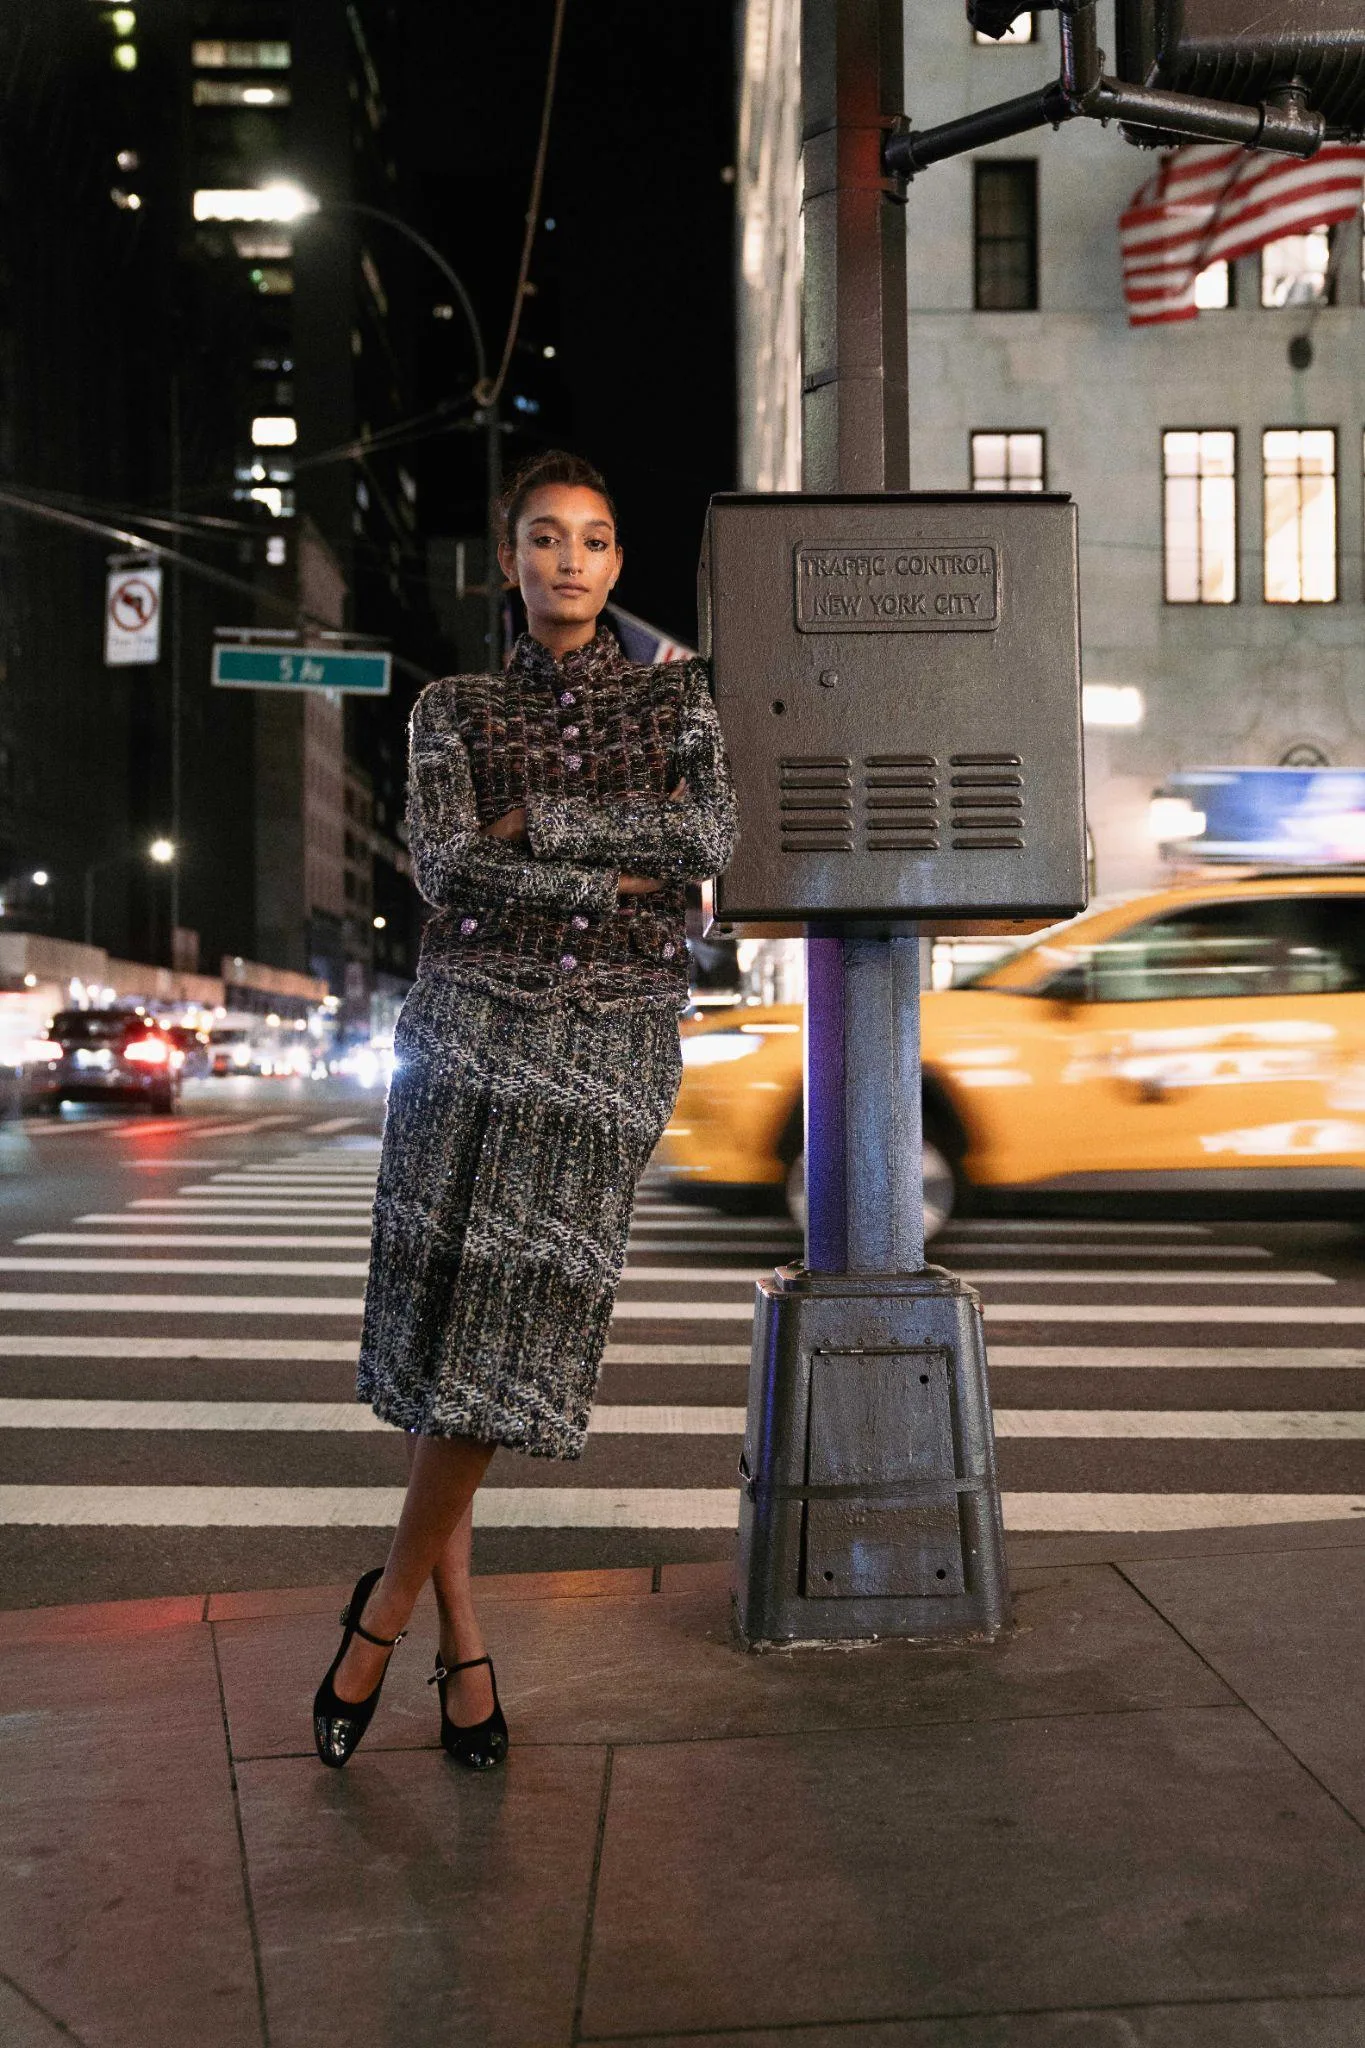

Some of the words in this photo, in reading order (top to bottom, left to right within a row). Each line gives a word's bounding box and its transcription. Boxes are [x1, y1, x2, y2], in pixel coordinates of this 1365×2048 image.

[801, 555, 886, 576] TRAFFIC
[895, 554, 992, 576] CONTROL
[814, 594, 862, 616] NEW
[869, 593, 926, 615] YORK
[934, 593, 982, 615] CITY
[300, 657, 325, 681] Av
